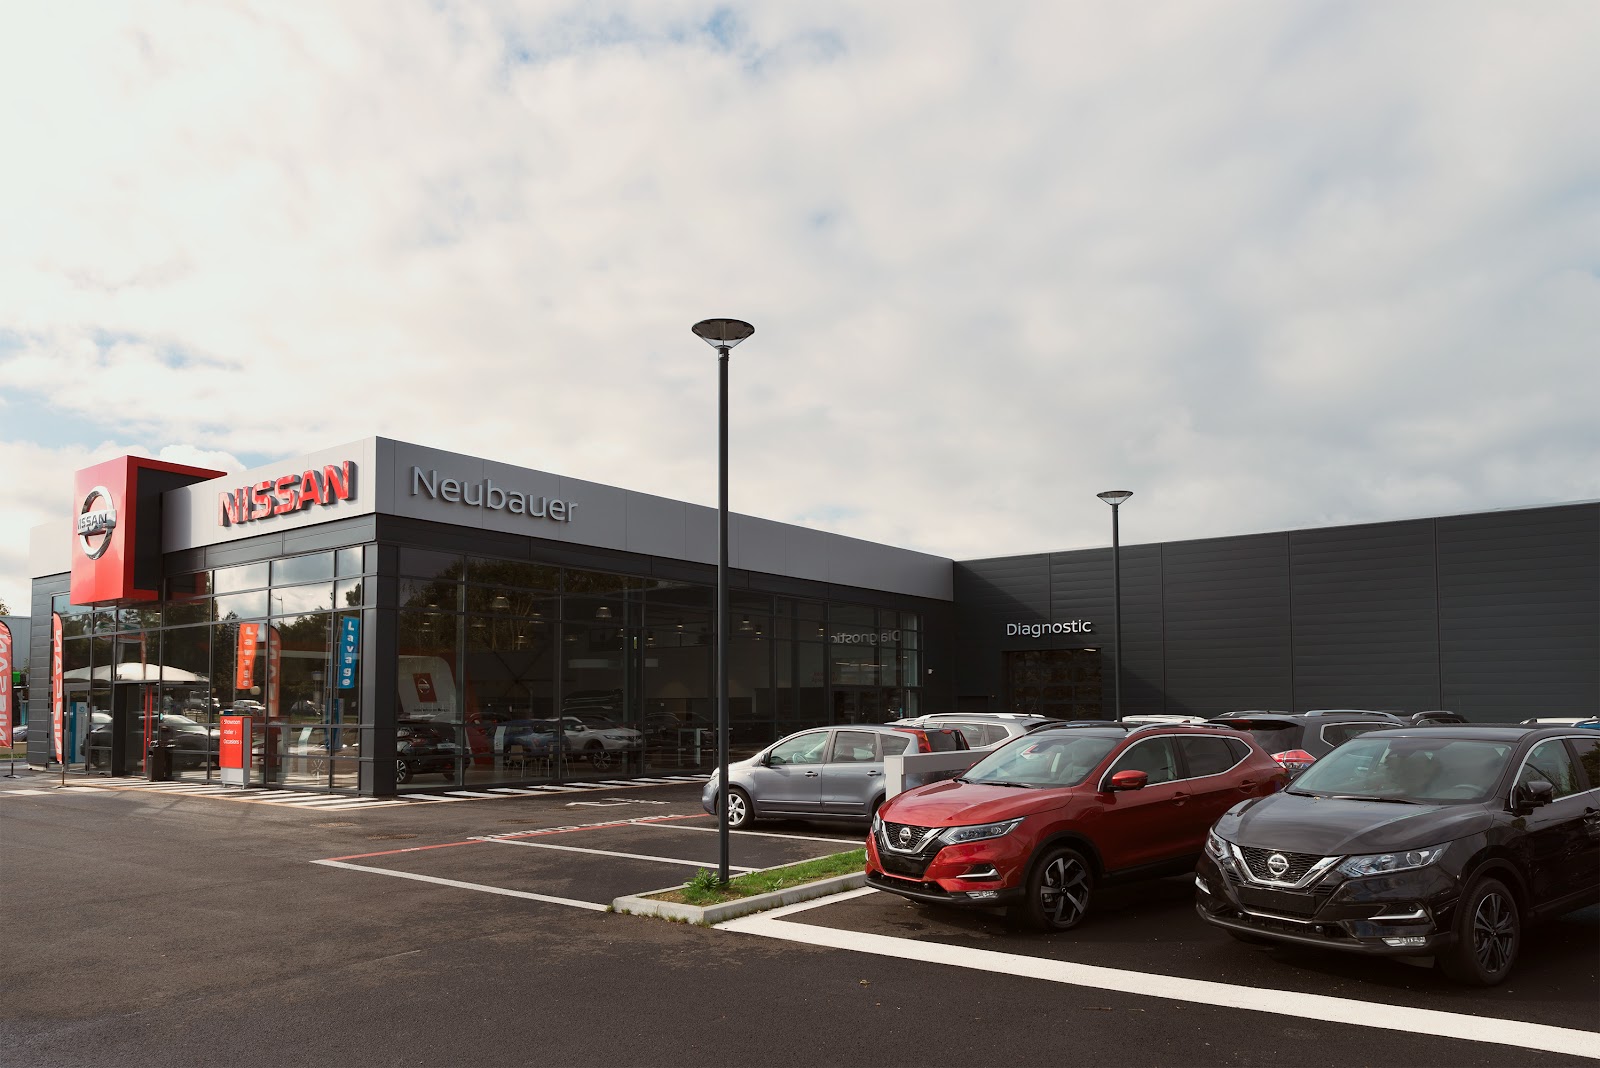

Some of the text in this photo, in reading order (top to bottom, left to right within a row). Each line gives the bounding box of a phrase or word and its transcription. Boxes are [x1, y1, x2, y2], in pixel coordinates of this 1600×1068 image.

[218, 460, 355, 526] NISSAN
[410, 465, 578, 522] Neubauer
[342, 621, 355, 686] Lavage
[1006, 619, 1092, 638] Diagnostic
